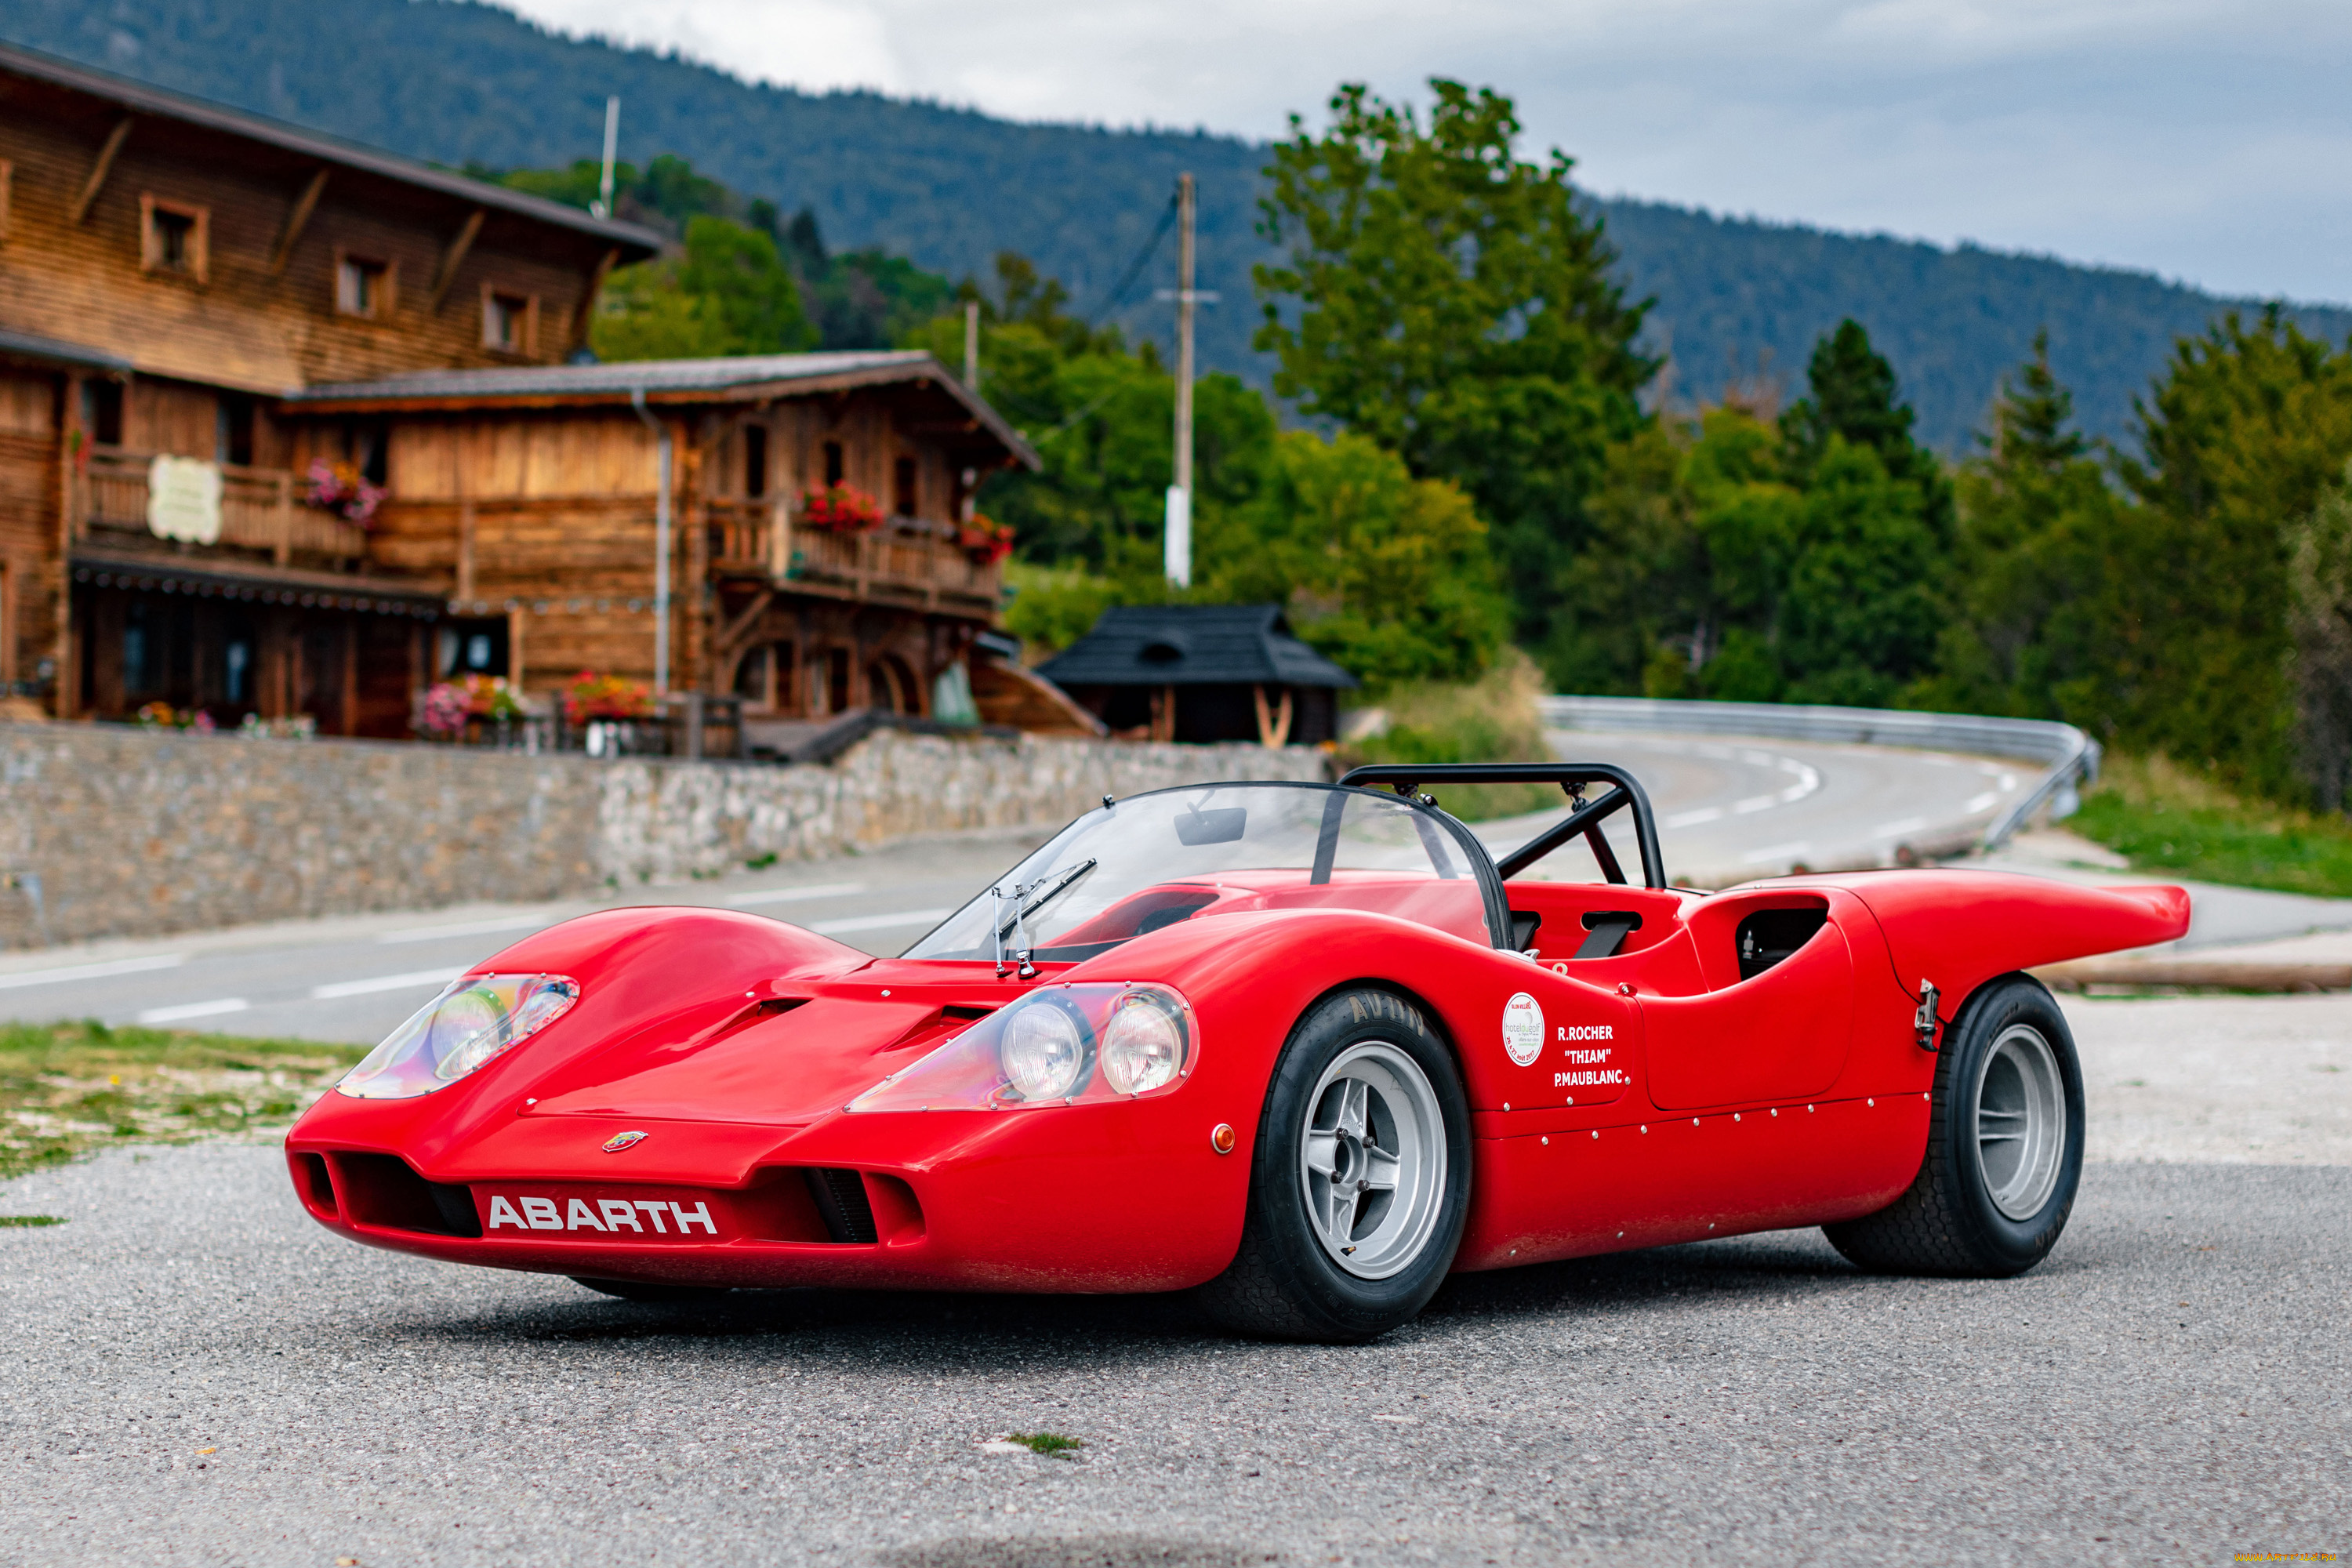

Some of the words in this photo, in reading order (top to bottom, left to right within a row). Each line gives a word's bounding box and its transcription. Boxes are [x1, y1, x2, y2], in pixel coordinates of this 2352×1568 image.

[1348, 993, 1425, 1037] AVON
[1558, 1025, 1613, 1041] R.ROCHER
[1564, 1048, 1611, 1065] "THIAM"
[1554, 1069, 1623, 1087] P.MAUBLANC
[489, 1196, 717, 1234] ABARTH
